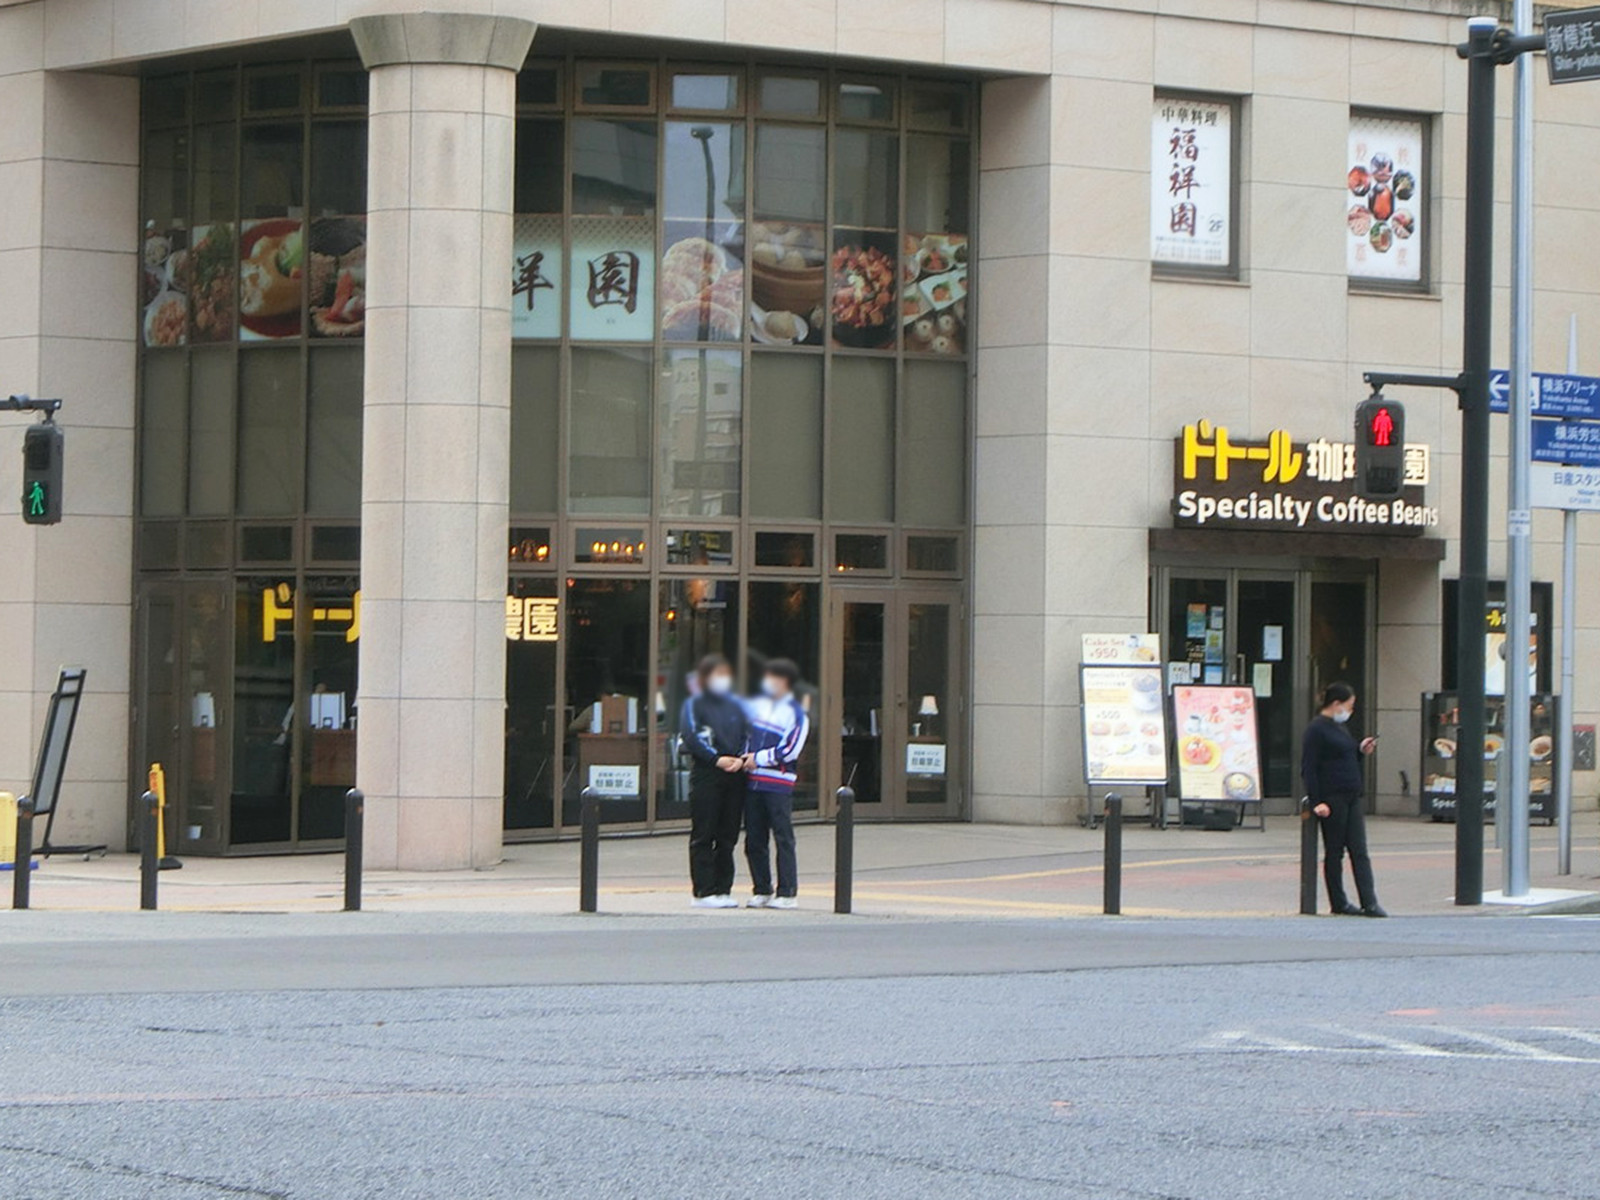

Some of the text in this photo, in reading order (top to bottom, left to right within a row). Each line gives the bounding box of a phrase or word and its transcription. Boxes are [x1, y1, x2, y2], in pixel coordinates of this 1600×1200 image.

[1162, 106, 1217, 125] 中華料理
[1542, 378, 1598, 396] 横浜アリーナ
[1179, 491, 1440, 527] Specialty Coffee Beans
